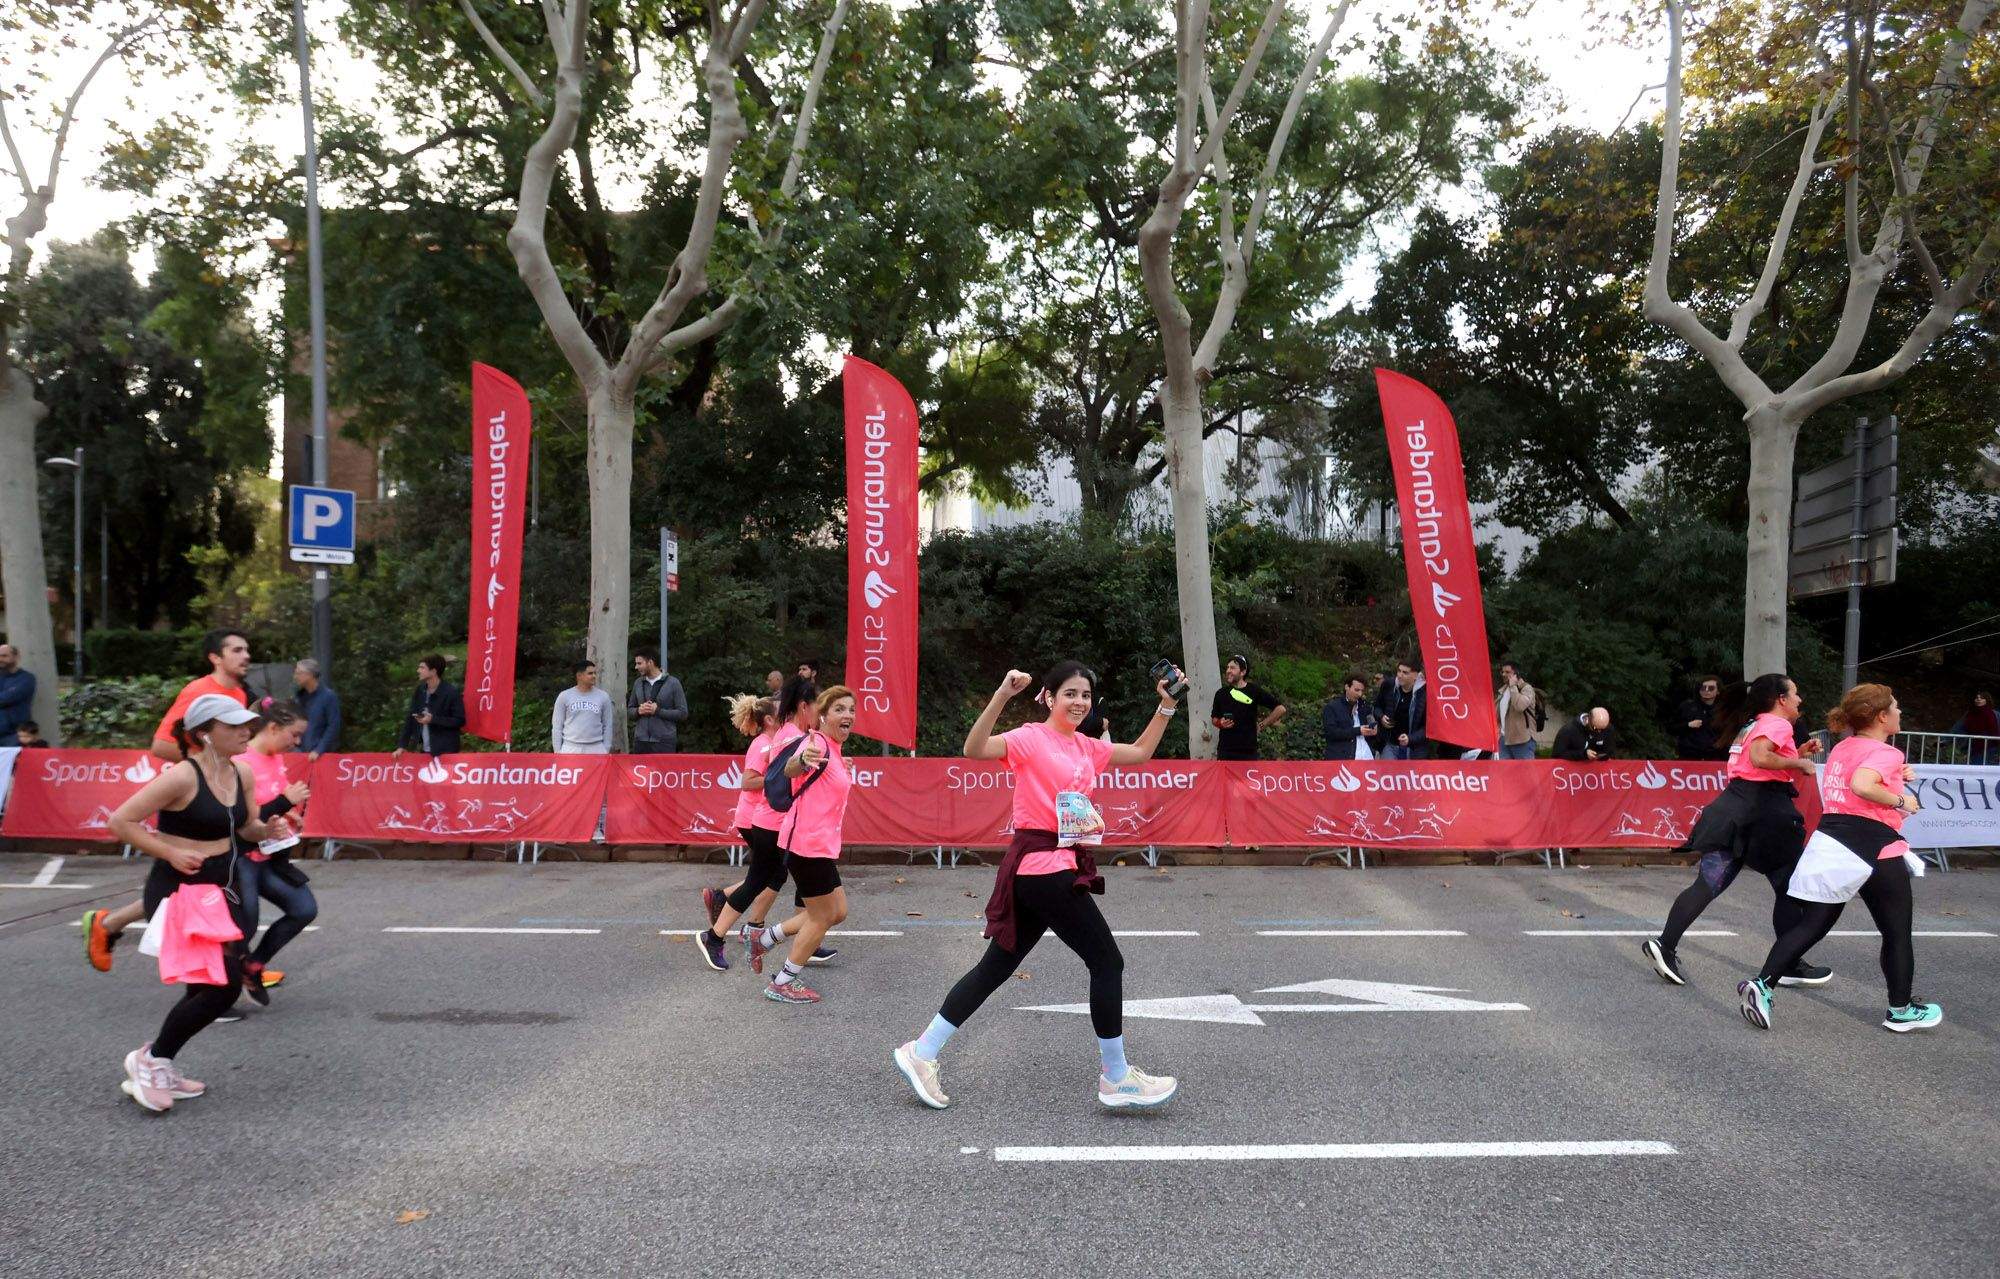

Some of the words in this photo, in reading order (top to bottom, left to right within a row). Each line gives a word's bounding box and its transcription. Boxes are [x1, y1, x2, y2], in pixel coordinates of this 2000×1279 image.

[303, 494, 342, 540] P
[569, 701, 600, 713] GUESS
[43, 757, 122, 785] Sports
[338, 757, 413, 787] Sports
[451, 762, 584, 785] Santander
[633, 765, 711, 793] Sports
[947, 765, 1013, 795] Sport
[1094, 768, 1198, 789] ntander
[1247, 770, 1325, 796] Sports
[1365, 770, 1490, 792] Santander
[1553, 768, 1631, 796] Sports
[1904, 778, 2000, 810] YSH
